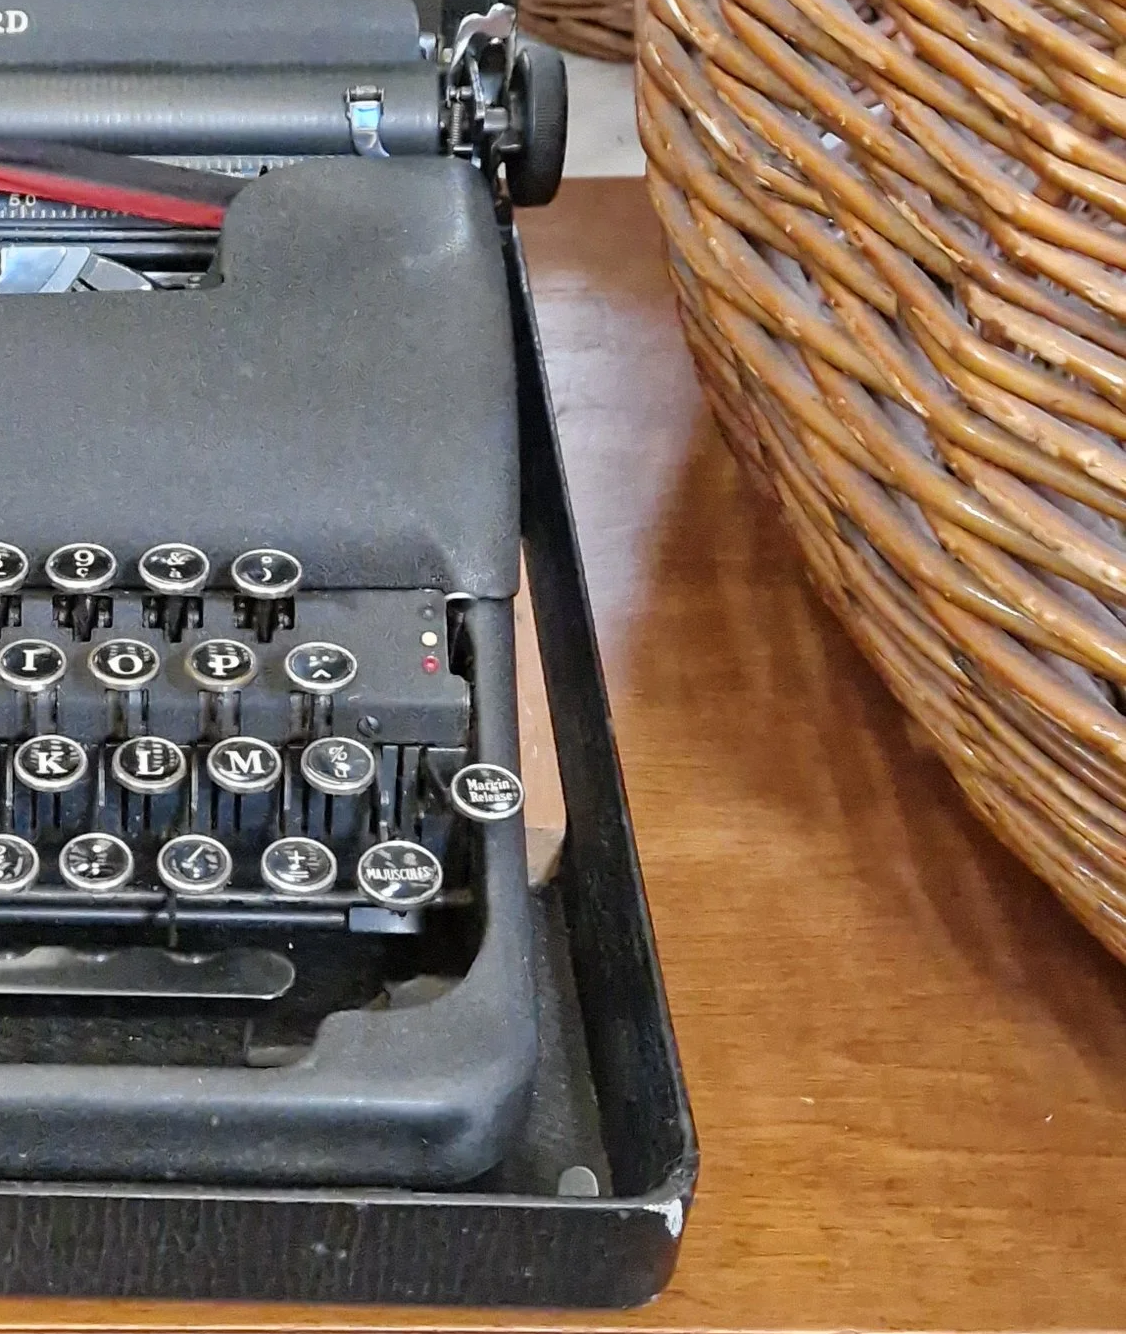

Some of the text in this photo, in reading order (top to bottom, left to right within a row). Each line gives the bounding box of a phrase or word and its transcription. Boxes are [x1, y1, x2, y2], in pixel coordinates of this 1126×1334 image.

[73, 549, 95, 567] 9
[21, 649, 38, 671] I
[108, 653, 143, 674] O
[208, 654, 240, 676] P
[36, 751, 68, 774] K
[135, 750, 165, 776] L
[225, 750, 266, 774] M
[466, 778, 511, 793] Margin
[469, 790, 513, 803] Release
[365, 865, 432, 881] MAJUSCULES
